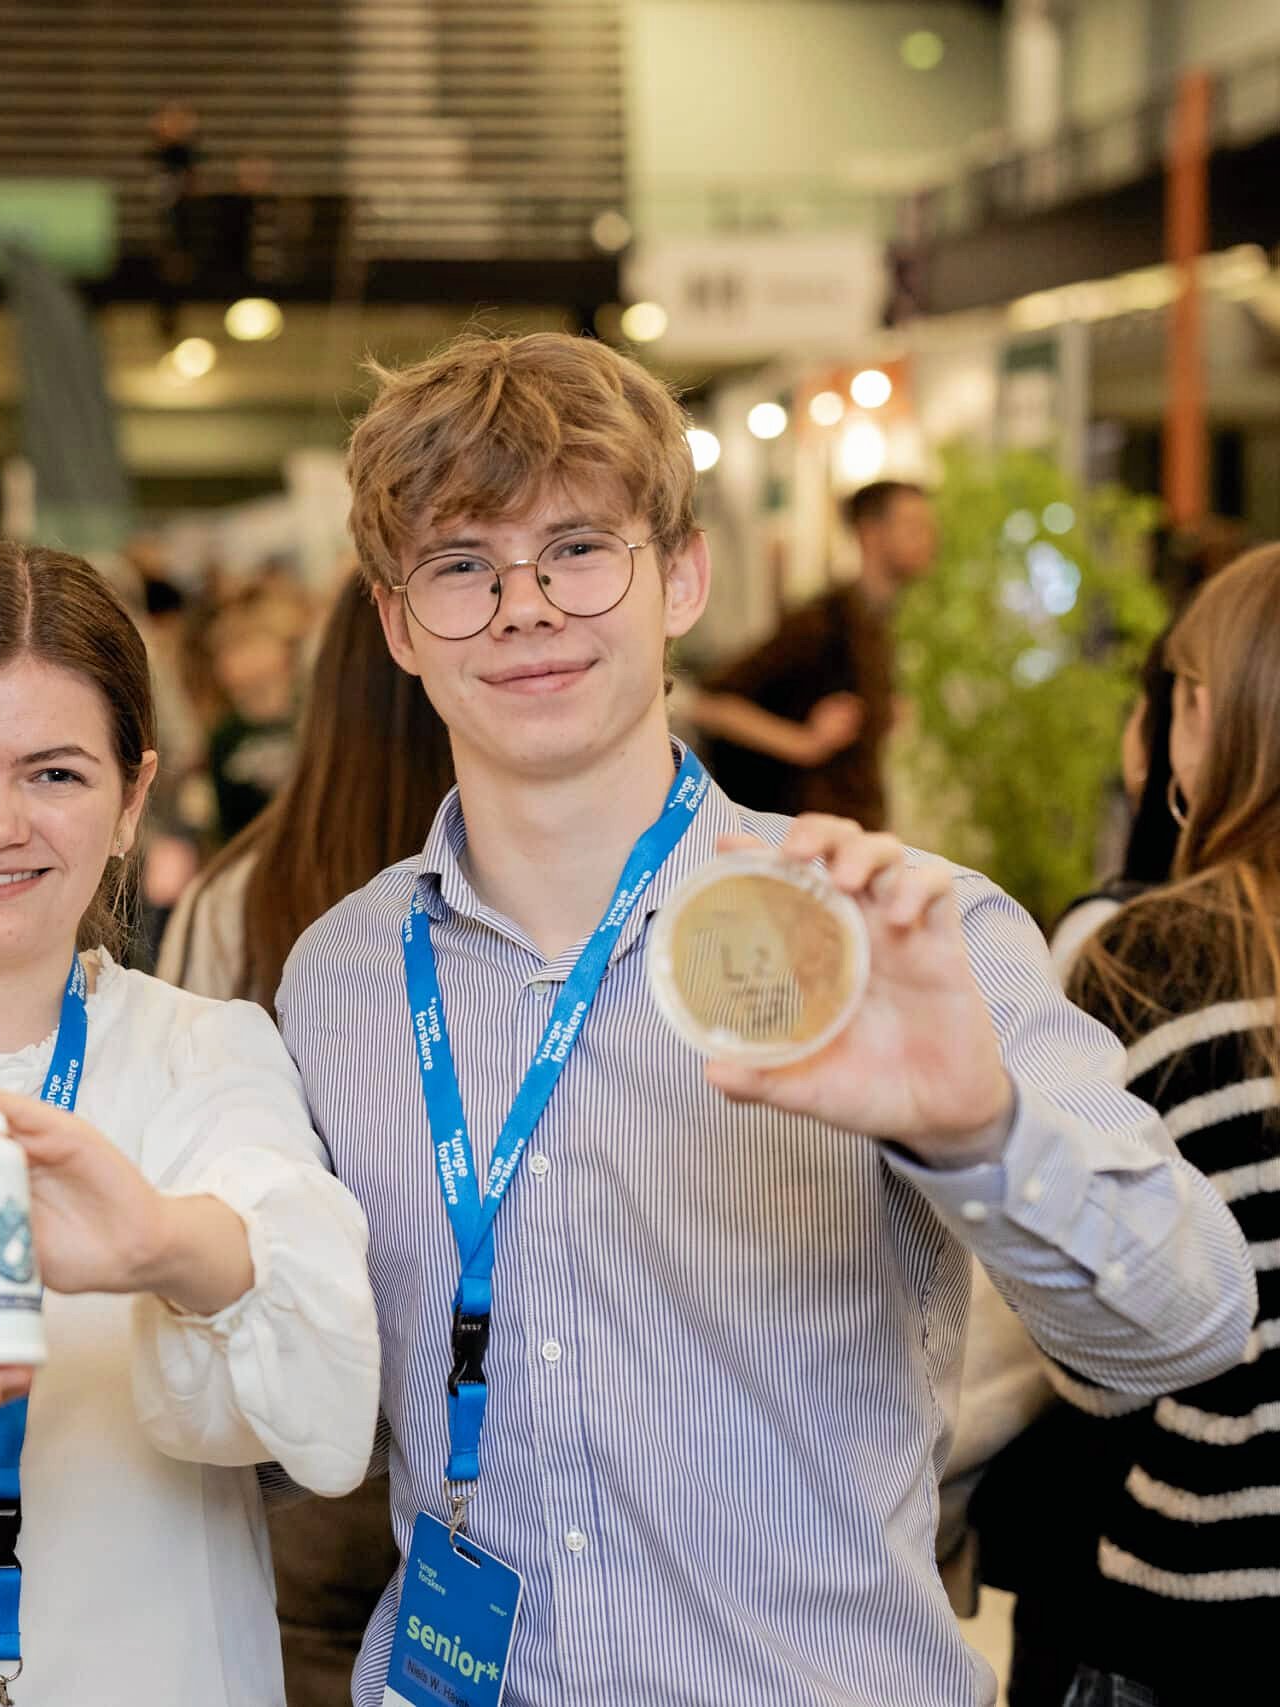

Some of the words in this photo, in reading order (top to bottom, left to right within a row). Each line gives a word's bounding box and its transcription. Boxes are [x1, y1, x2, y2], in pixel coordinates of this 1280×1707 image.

[613, 870, 652, 927] forskere
[416, 1010, 433, 1071] forskere
[550, 1001, 587, 1063] forskere
[437, 1141, 459, 1205] forskere
[490, 1138, 525, 1198] forskere
